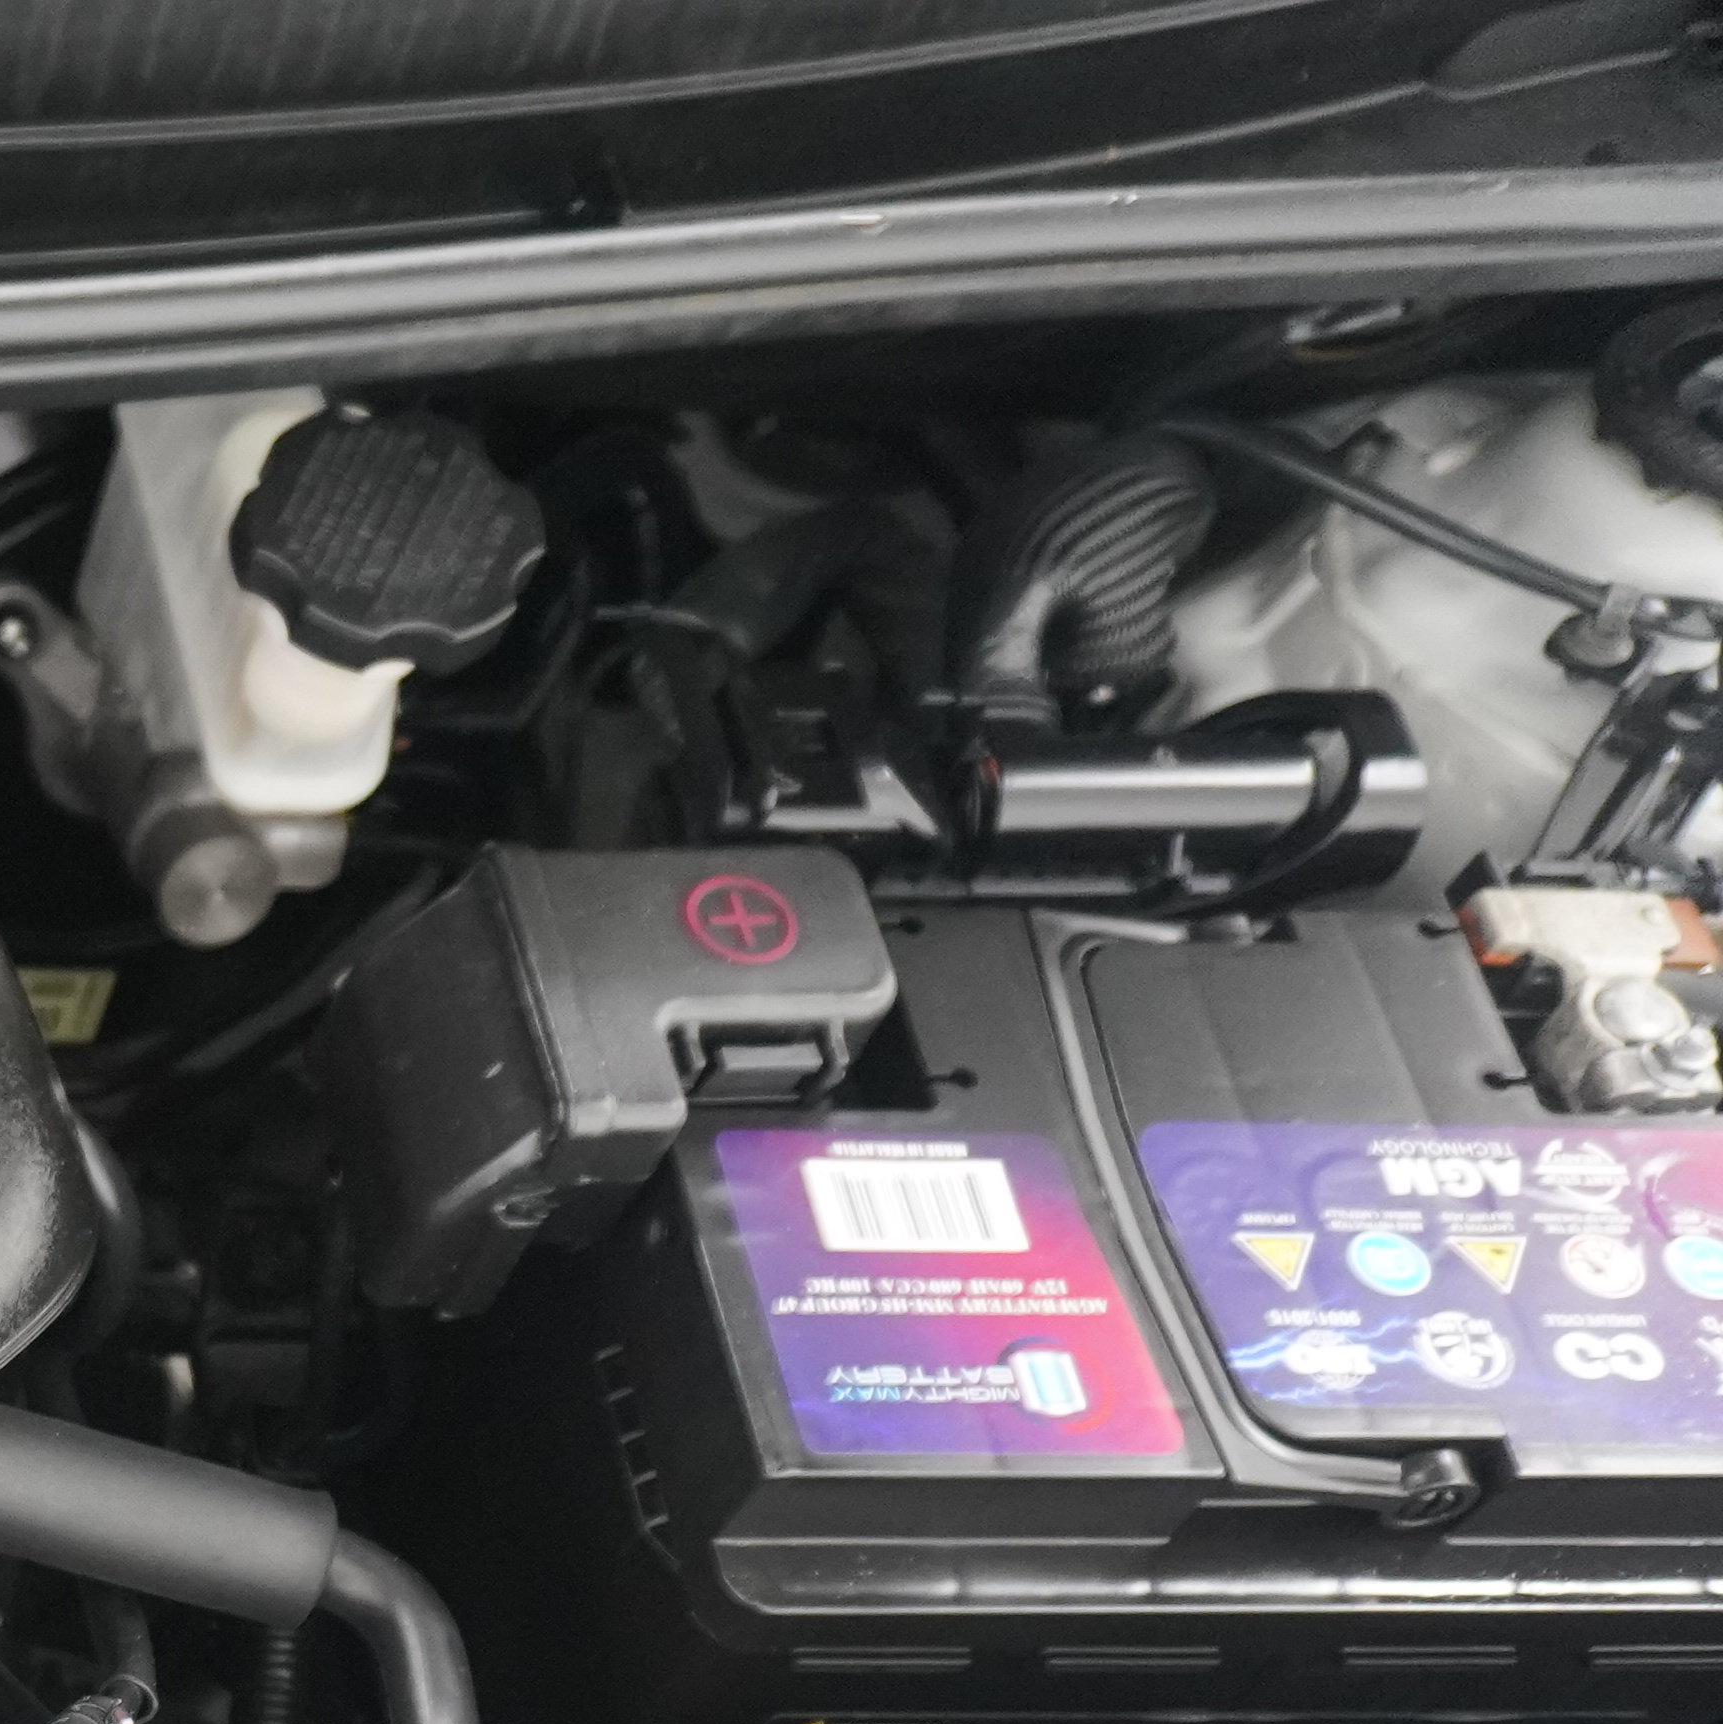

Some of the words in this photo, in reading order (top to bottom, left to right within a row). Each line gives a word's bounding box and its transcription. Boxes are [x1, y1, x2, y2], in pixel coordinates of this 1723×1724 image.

[1366, 1139, 1516, 1158] TECHNOLOGY
[1379, 1157, 1522, 1198] AGM
[875, 1277, 927, 1295] CCA
[1031, 1277, 1068, 1296] 12V
[959, 1296, 1057, 1316] BATTERY
[824, 1364, 1015, 1386] BATTERY
